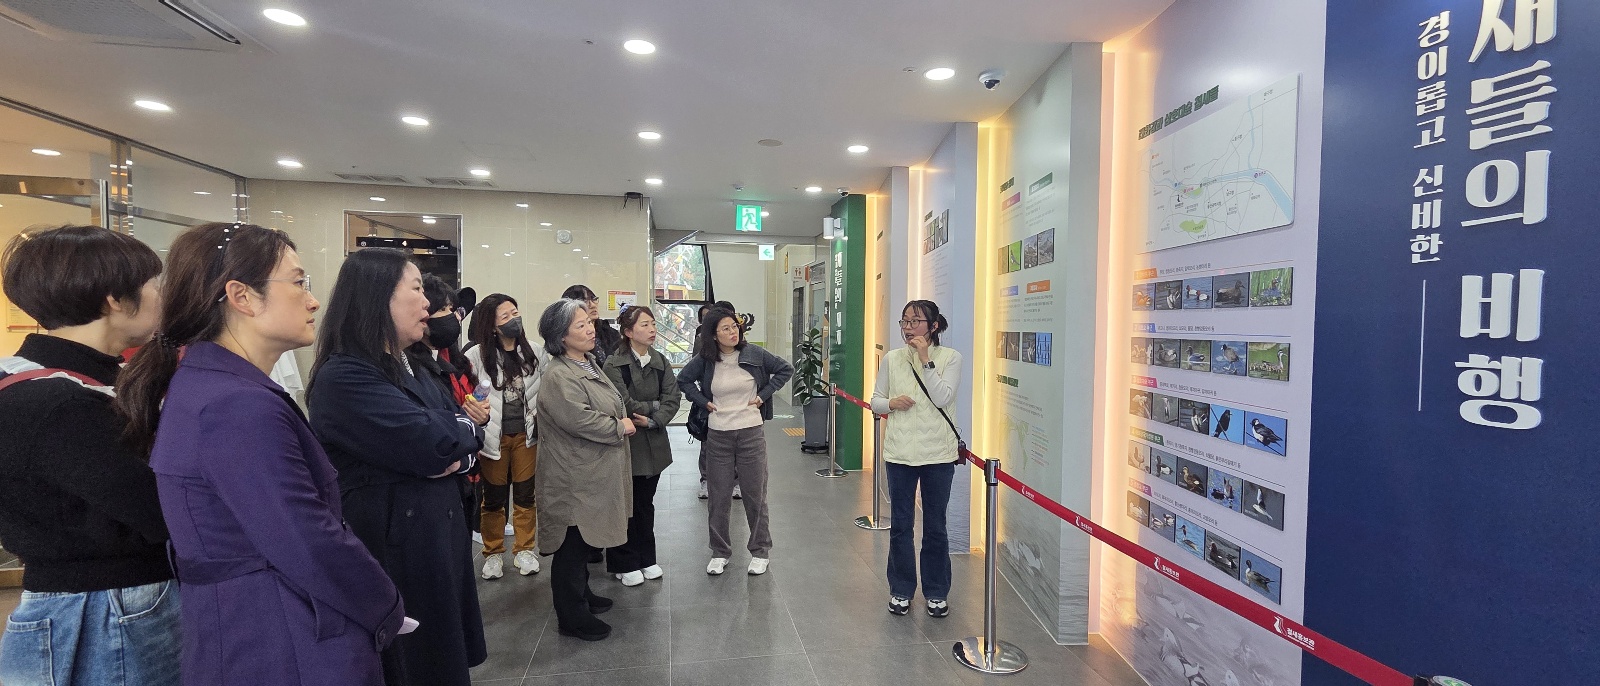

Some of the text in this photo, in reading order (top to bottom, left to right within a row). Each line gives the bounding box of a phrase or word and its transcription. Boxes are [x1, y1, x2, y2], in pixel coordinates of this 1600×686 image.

[1193, 84, 1219, 111] 철새들
[1409, 9, 1451, 264] 경이롭고 신비한
[1454, 0, 1558, 430] 새들의 비행
